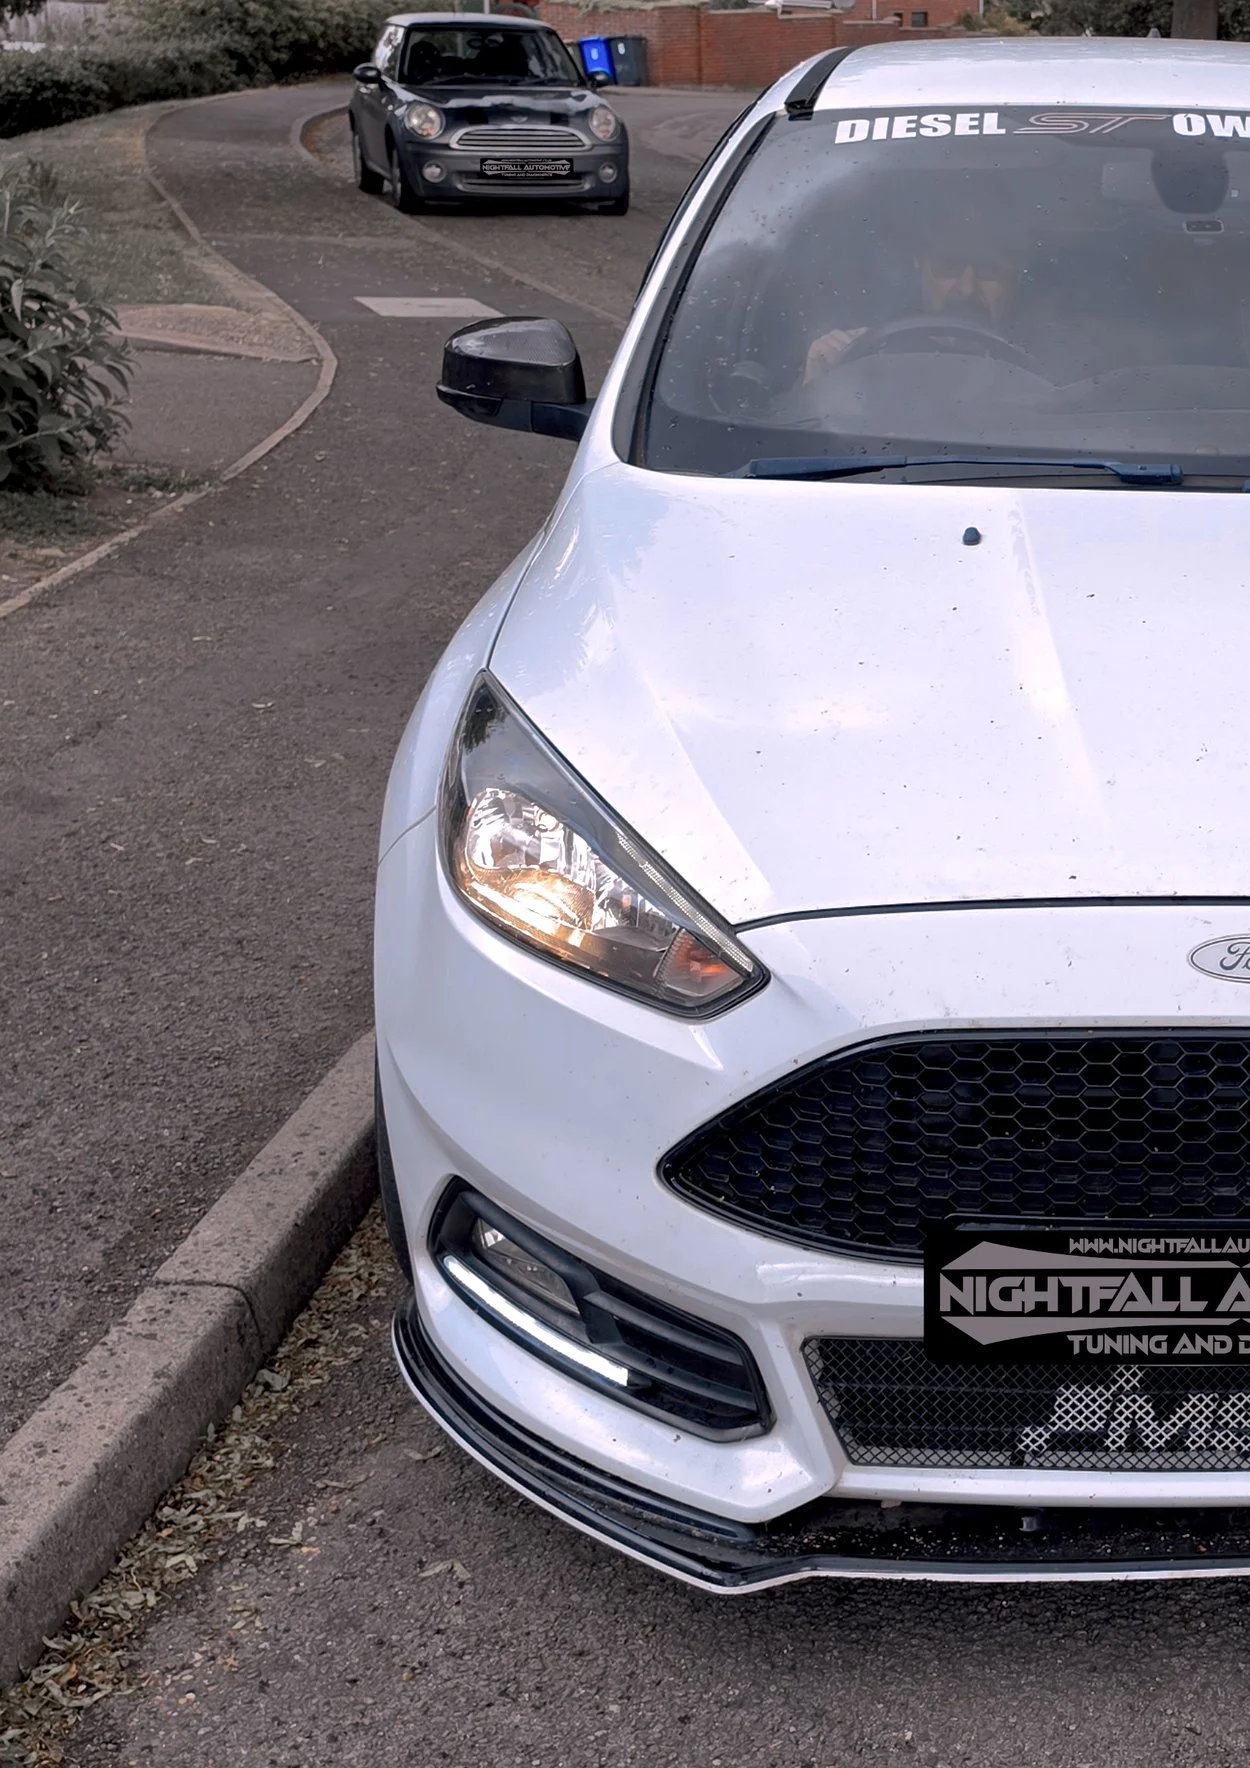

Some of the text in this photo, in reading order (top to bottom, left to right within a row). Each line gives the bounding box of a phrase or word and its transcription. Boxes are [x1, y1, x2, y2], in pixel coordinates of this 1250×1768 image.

[834, 112, 1006, 144] DIESEL
[1013, 112, 1173, 134] ST
[939, 1271, 1208, 1316] NIGHTFALL
[1066, 1333, 1169, 1357] TUNING
[1171, 1333, 1233, 1357] AND
